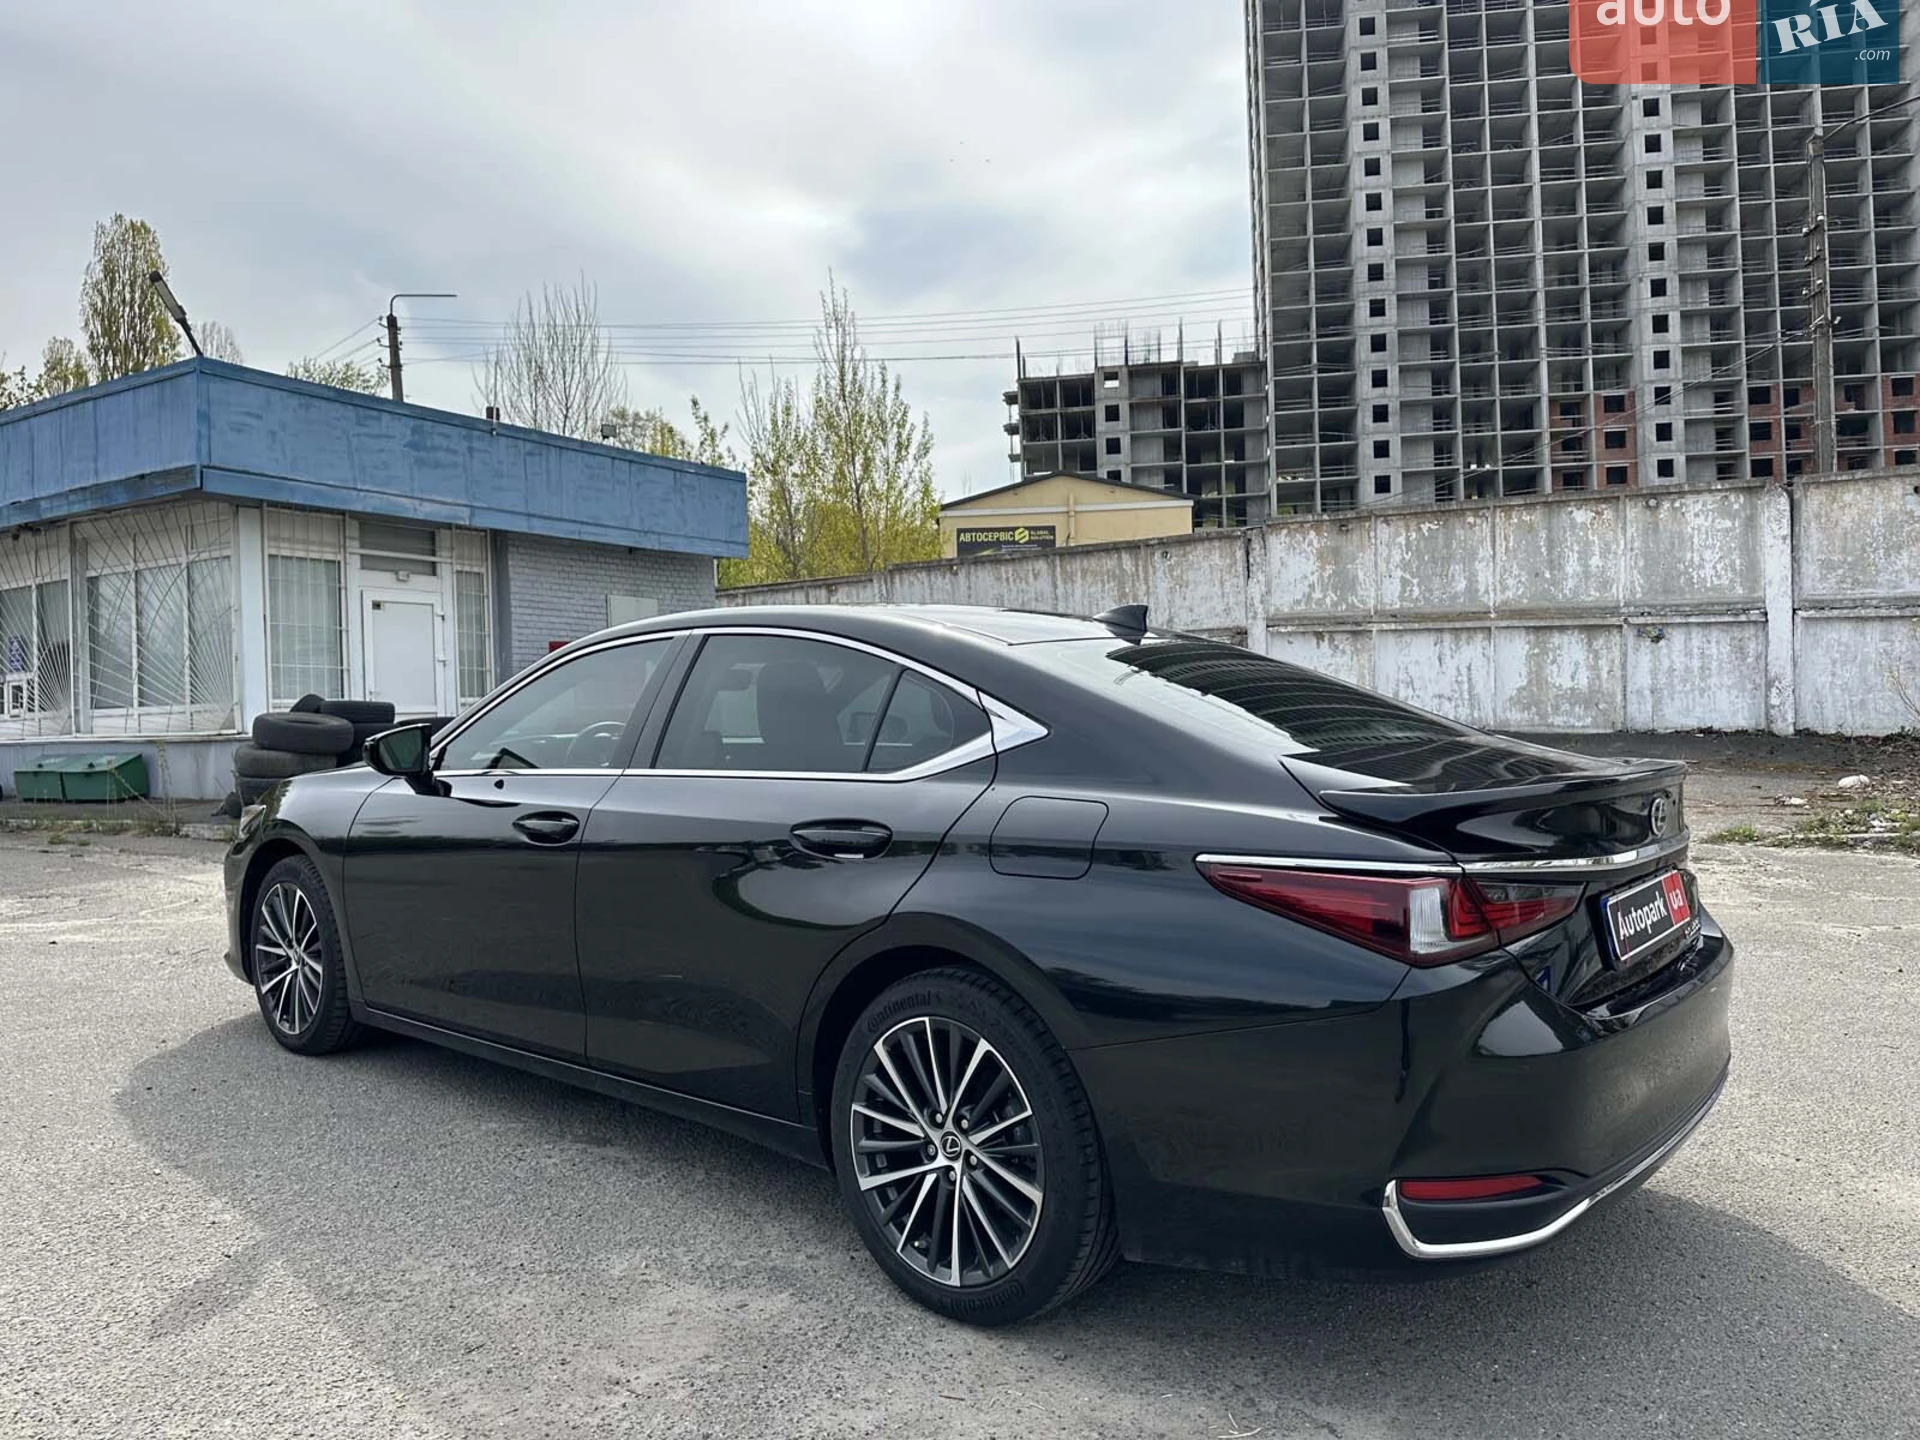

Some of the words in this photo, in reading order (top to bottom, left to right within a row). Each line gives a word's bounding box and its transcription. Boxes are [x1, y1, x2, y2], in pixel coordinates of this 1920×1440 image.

[959, 531, 1014, 543] АВТОСЕРВІС
[1617, 891, 1668, 941] Autopark
[1669, 888, 1684, 910] ua
[867, 989, 932, 1033] Continental
